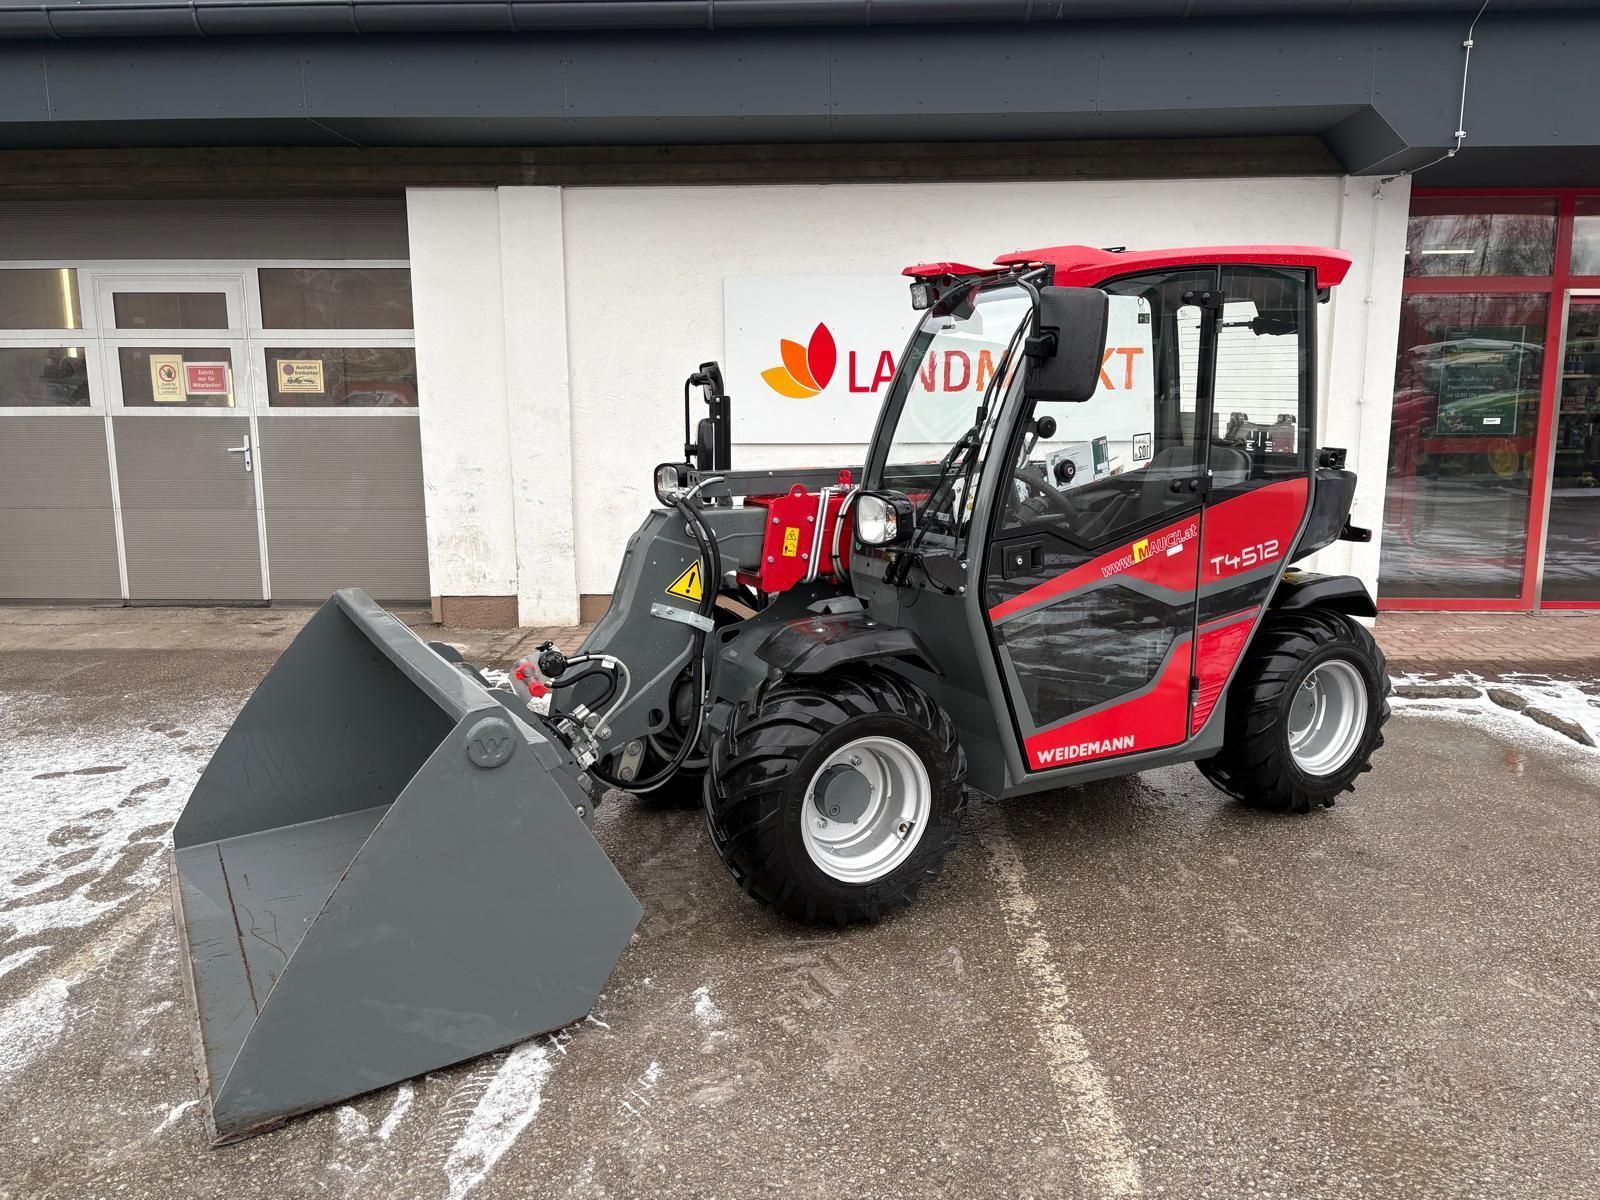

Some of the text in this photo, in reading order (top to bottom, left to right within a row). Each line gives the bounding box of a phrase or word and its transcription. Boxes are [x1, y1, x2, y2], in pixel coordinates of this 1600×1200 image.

[1101, 523, 1198, 578] www.MAUCH.at
[1210, 539, 1280, 575] T4512
[1037, 735, 1135, 764] WEIDEMANN
